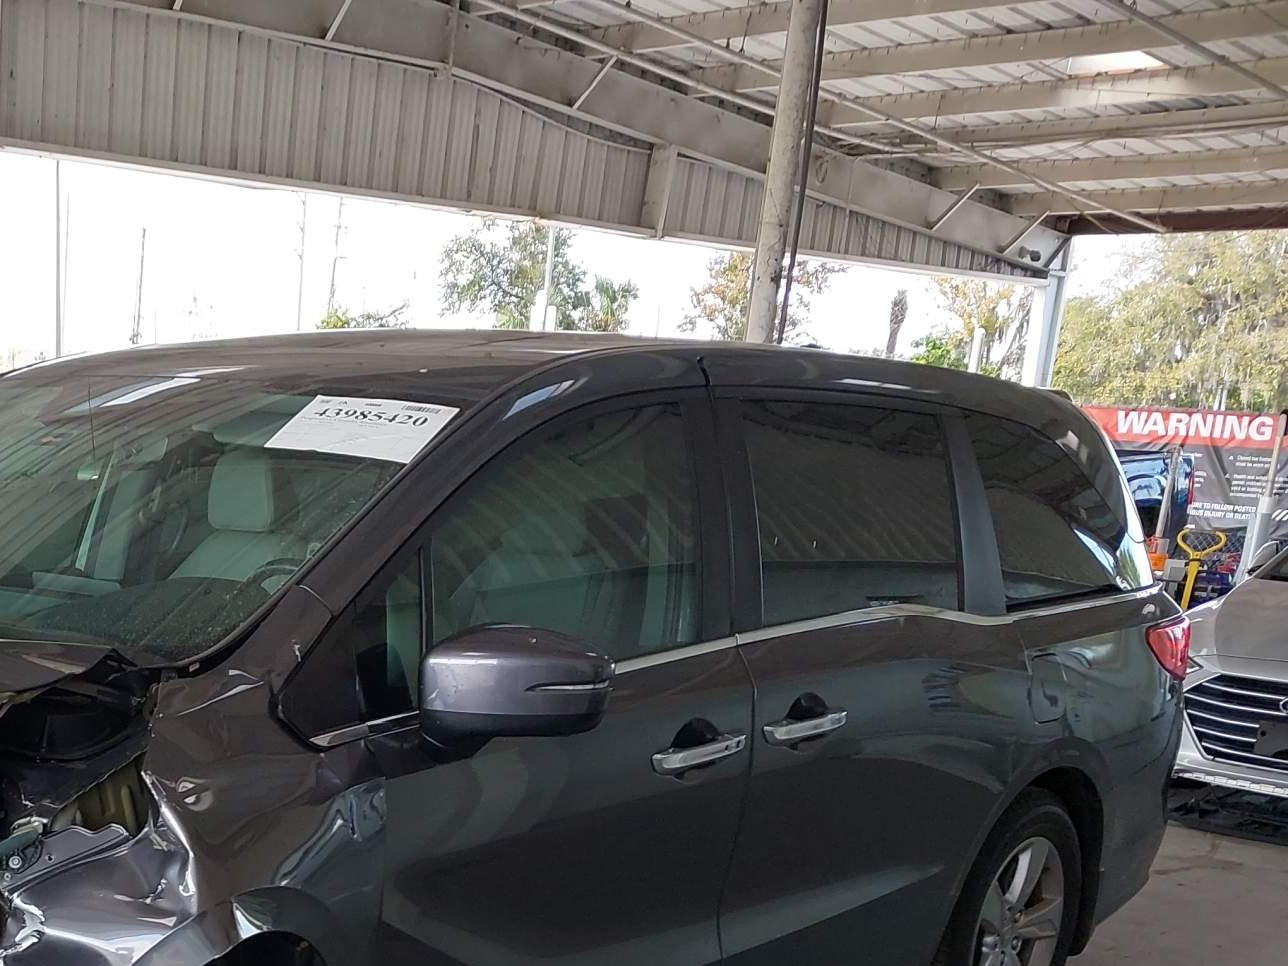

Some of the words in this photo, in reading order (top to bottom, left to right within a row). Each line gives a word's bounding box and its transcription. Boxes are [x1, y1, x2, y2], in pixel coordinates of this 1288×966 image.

[313, 407, 429, 427] 43985420
[1117, 410, 1274, 441] WARNING
[1204, 510, 1226, 518] INJURY
[1211, 503, 1234, 511] FOLLOW
[1234, 505, 1257, 513] POSTED
